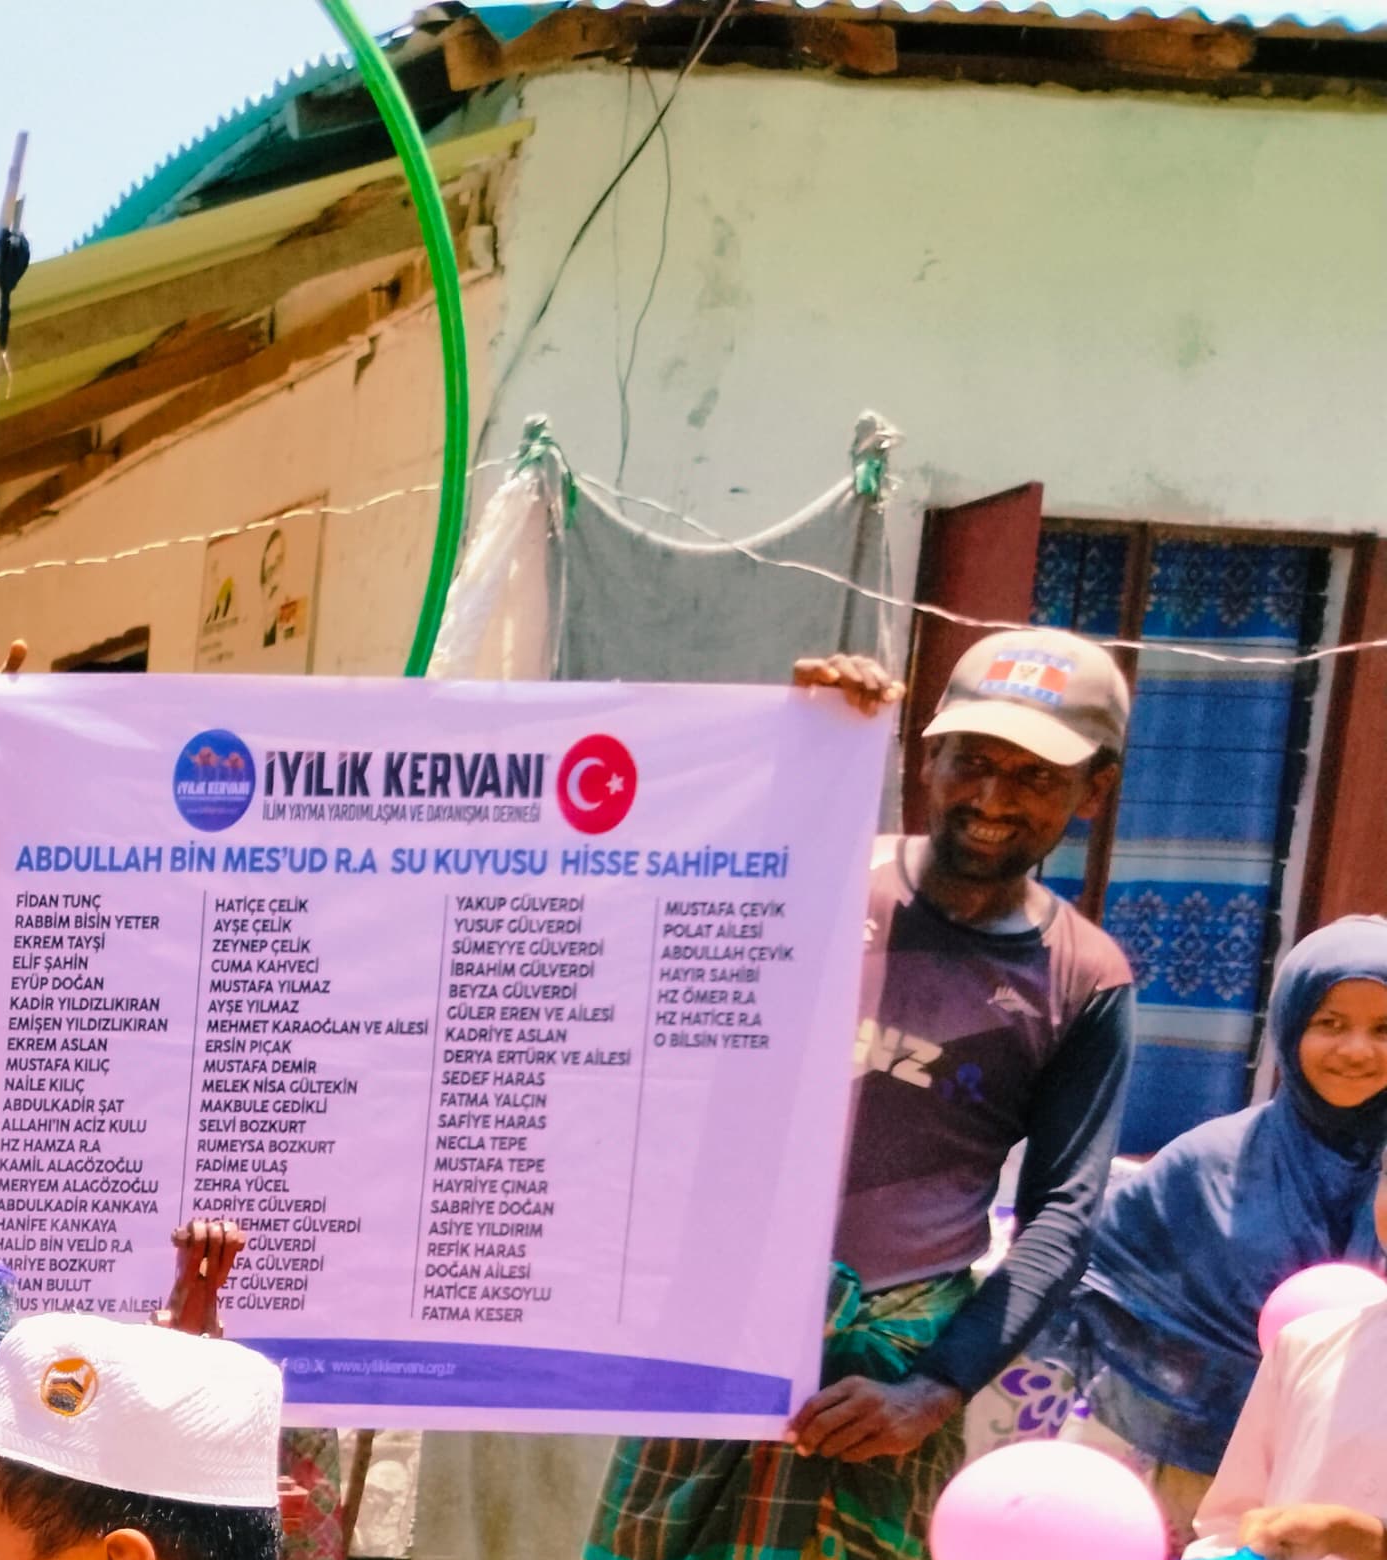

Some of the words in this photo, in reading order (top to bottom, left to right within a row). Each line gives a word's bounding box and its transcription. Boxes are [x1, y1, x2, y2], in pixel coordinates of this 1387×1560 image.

[264, 751, 373, 797] İYİLİK
[383, 752, 545, 798] KERVANI
[288, 804, 325, 821] YAYMA
[410, 804, 425, 821] VE
[15, 845, 162, 872] ABDULLAH
[170, 840, 215, 872] BİN
[335, 848, 377, 873] R.A
[391, 848, 426, 875] SU
[434, 849, 548, 875] KUYUSU
[560, 844, 640, 877] HİSSE
[646, 845, 789, 878] SAHİPLERİ
[16, 891, 59, 908] FİDAN
[63, 895, 101, 911] TUNÇ
[269, 896, 309, 916] ÇELİK
[455, 896, 506, 911] YAKUP
[664, 901, 735, 916] MUSTAFA
[15, 912, 70, 929] RABBİM
[75, 912, 110, 929] BİSİN
[115, 915, 160, 930] YETER
[213, 919, 249, 935] AYŞE
[252, 917, 292, 935] ÇELİK
[663, 924, 713, 938] POLAT
[14, 936, 64, 949] EKREM
[68, 933, 105, 953] TAYŞİ
[212, 939, 268, 953] ZEYNEP
[271, 937, 311, 956] ÇELİK
[13, 953, 41, 969] ELİF
[44, 953, 88, 973] ŞAHİN
[11, 973, 48, 990] EYÜP
[52, 973, 104, 990] DOĞAN
[209, 980, 274, 993] MUSTAFA
[278, 980, 331, 993] YILMAZ
[10, 994, 54, 1010] KADİR
[500, 1006, 540, 1021] EREN
[545, 1008, 565, 1021] VE
[207, 1020, 269, 1033] MEHMET
[272, 1018, 360, 1034] KARAOĞLAN
[364, 1021, 382, 1034] VE
[385, 1019, 428, 1035] AİLESİ
[205, 1037, 246, 1053] ERSİN
[249, 1040, 292, 1056] PIÇAK
[203, 1060, 267, 1073] MUSTAFA
[272, 1057, 317, 1073] DEMİR
[443, 1049, 492, 1063] DERYA
[561, 1051, 581, 1065] VE
[6, 1058, 70, 1071] MUSTAFA
[75, 1059, 110, 1075] KILIÇ
[4, 1075, 46, 1091] NAİLE
[49, 1078, 85, 1094] KILIÇ
[202, 1080, 249, 1093] MELEK
[253, 1077, 286, 1093] NİSA
[290, 1077, 358, 1094] GÜLTEKİN
[3, 1096, 95, 1112] ABDULKADİR
[98, 1099, 125, 1116] ŞAT
[200, 1099, 269, 1113] MAKBULE
[273, 1097, 327, 1114] GEDİKLİ
[74, 1116, 105, 1133] ACİZ
[109, 1120, 147, 1133] KULU
[199, 1117, 236, 1133] SELVİ
[240, 1120, 306, 1133] BOZKURT
[0, 1139, 20, 1152] HZ
[24, 1139, 75, 1152] HAMZA
[197, 1139, 265, 1153] RUMEYSA
[269, 1140, 336, 1154] BOZKURT
[436, 1136, 485, 1150] NECLA
[490, 1137, 527, 1151] TEPE
[0, 1156, 43, 1172] KAMİL
[47, 1157, 143, 1173] ALAGÖZOĞLU
[196, 1156, 248, 1172] FADİME
[252, 1160, 288, 1176] ULAŞ
[434, 1157, 503, 1172] MUSTAFA
[508, 1158, 545, 1173] TEPE
[194, 1179, 241, 1191] ZEHRA
[245, 1176, 290, 1192] YÜCEL
[91, 1200, 158, 1214] KANKAYA
[193, 1195, 255, 1211] KADRİYE
[258, 1196, 326, 1213] GÜLVERDİ
[50, 1219, 117, 1233] KANKAYA
[293, 1217, 361, 1232] GÜLVERDİ
[40, 1236, 63, 1251] BİN
[67, 1237, 107, 1252] VELİD
[248, 1236, 316, 1252] GÜLVERDİ
[49, 1259, 116, 1272] BOZKURT
[47, 1279, 91, 1291] BULUT
[481, 1286, 551, 1301] AKSOYLU
[42, 1298, 94, 1312] YILMAZ
[97, 1298, 115, 1312] VE
[422, 1306, 470, 1321] FATMA
[474, 1307, 523, 1322] KESER
